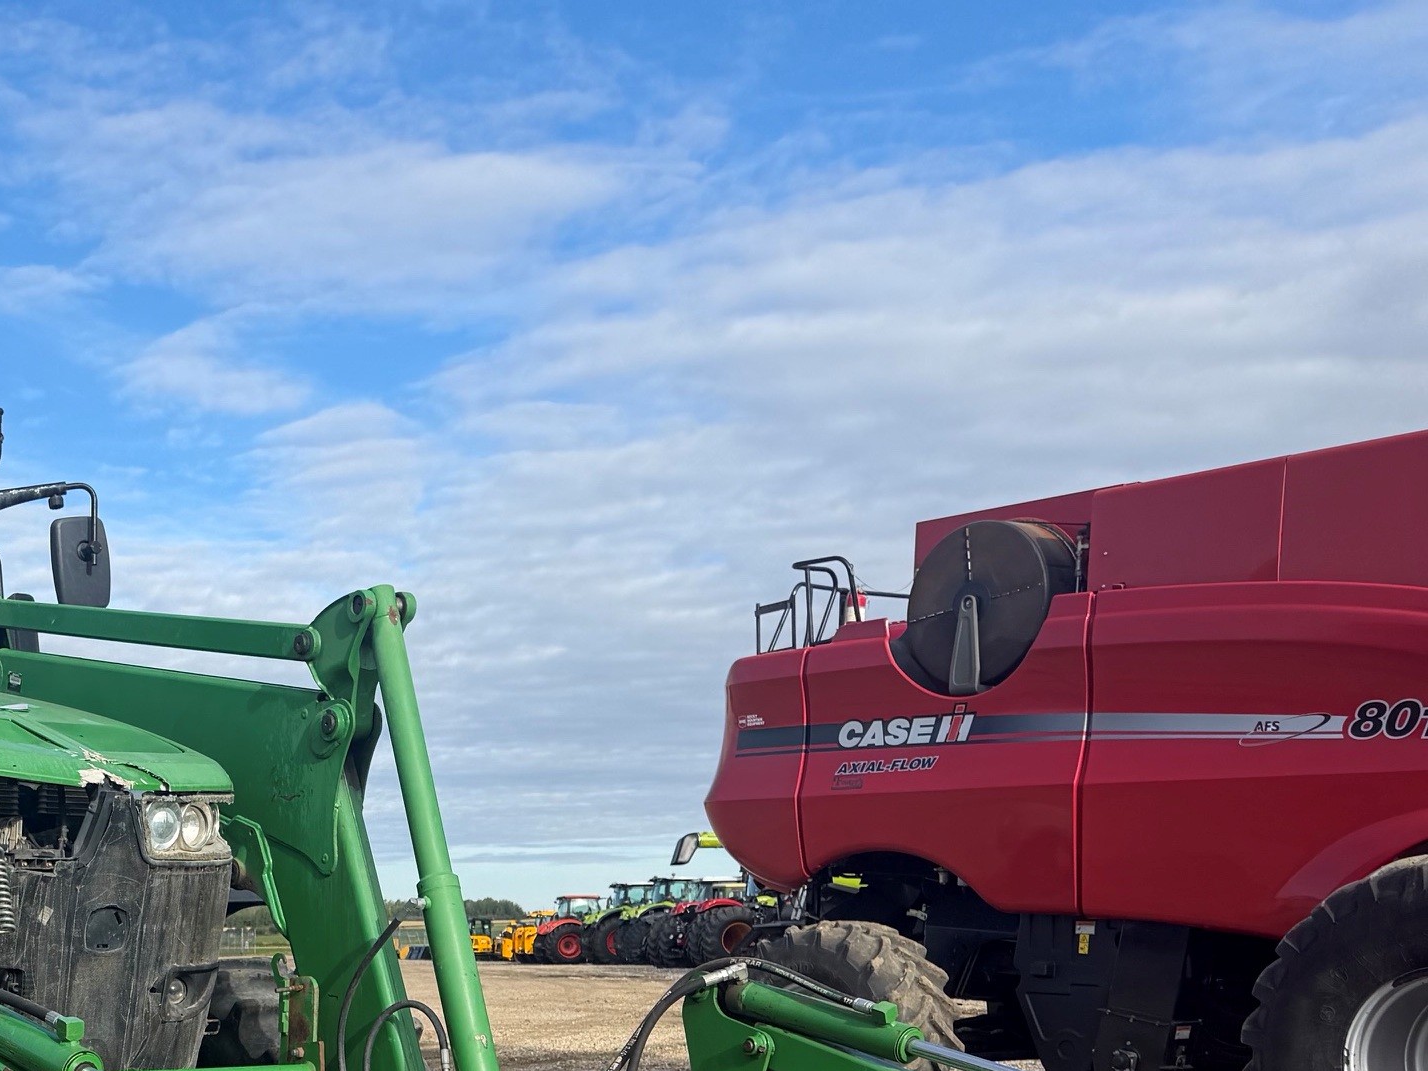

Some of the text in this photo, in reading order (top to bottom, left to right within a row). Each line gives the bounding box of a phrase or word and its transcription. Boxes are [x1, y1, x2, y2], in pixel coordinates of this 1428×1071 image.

[838, 717, 934, 748] CASE
[1254, 721, 1280, 732] AFS
[835, 756, 939, 775] AXIAL-FLOW
